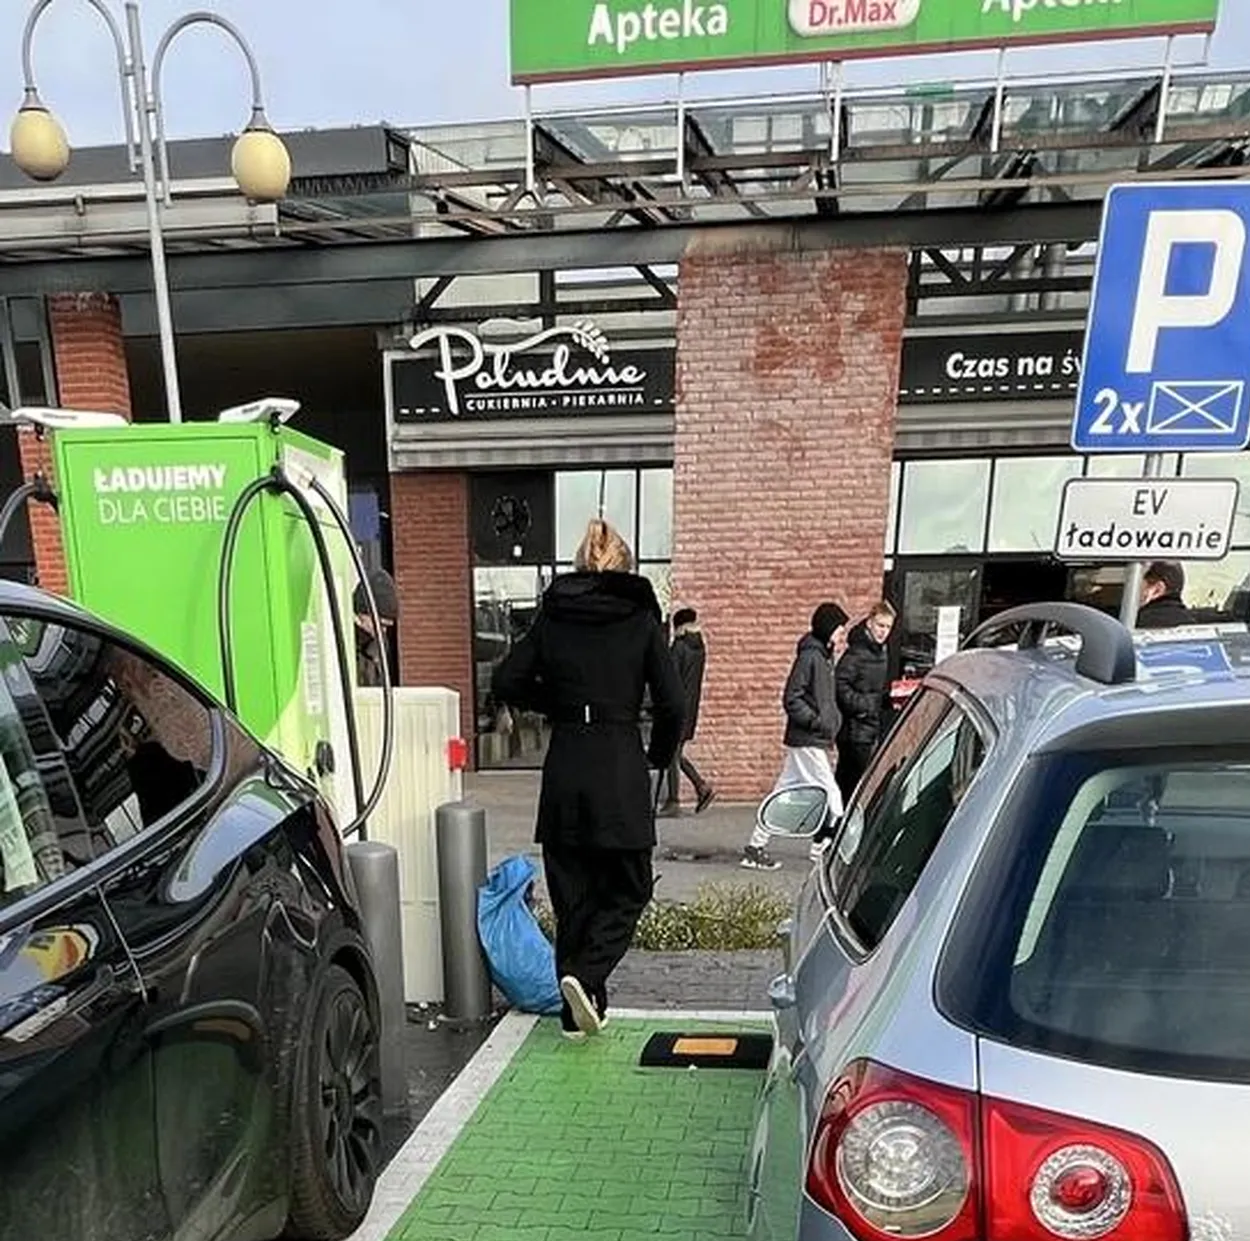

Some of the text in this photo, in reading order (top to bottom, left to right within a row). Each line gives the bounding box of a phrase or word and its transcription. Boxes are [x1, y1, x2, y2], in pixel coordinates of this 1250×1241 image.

[808, 0, 897, 26] Dr.Max
[587, 0, 729, 54] Apteka
[1125, 209, 1246, 373] P
[946, 352, 1009, 379] Czas
[1017, 357, 1053, 376] na
[466, 393, 645, 411] CUKIERNIA PIEKARNIA
[1089, 389, 1147, 434] 2x
[94, 464, 226, 492] ŁADUJEMY
[100, 496, 228, 523] DLA CIEBIE
[1133, 489, 1169, 517] EV
[1066, 524, 1222, 550] ładowanie
